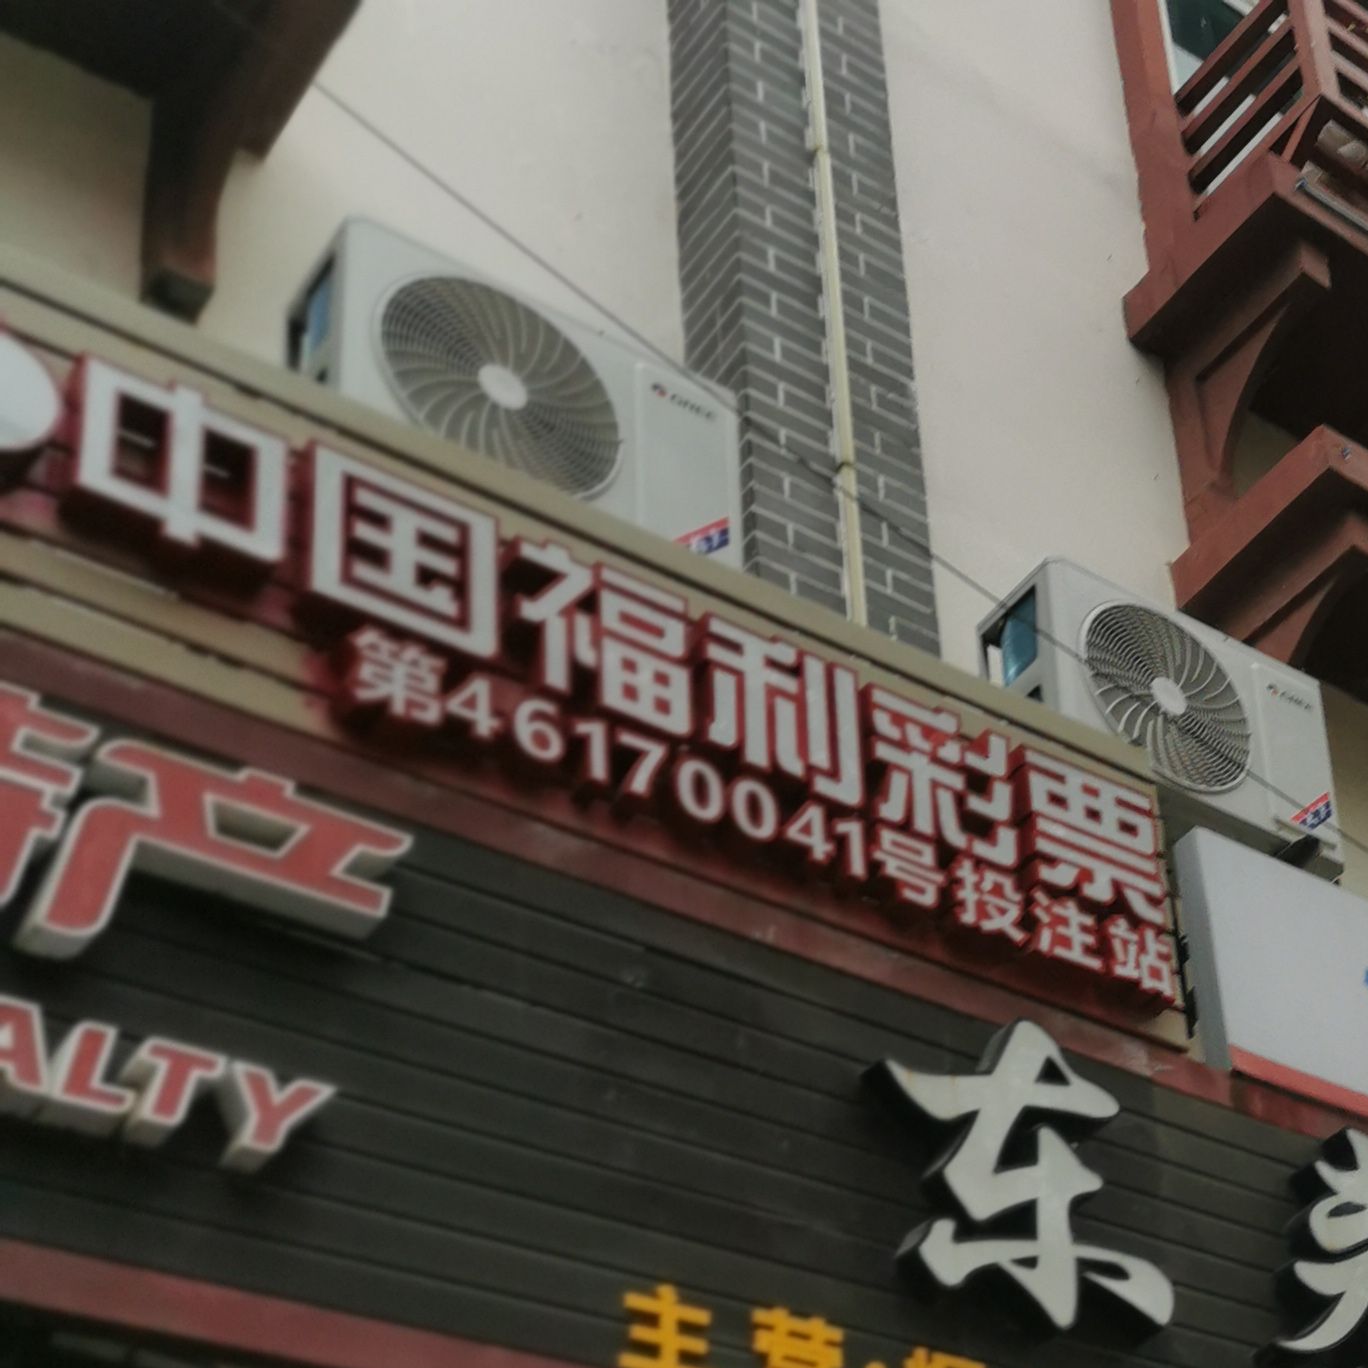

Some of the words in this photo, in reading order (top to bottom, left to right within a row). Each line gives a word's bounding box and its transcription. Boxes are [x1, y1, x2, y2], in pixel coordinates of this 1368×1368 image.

[78, 353, 1168, 925] 中国福利彩票
[350, 627, 1175, 997] 第46170041号投注站
